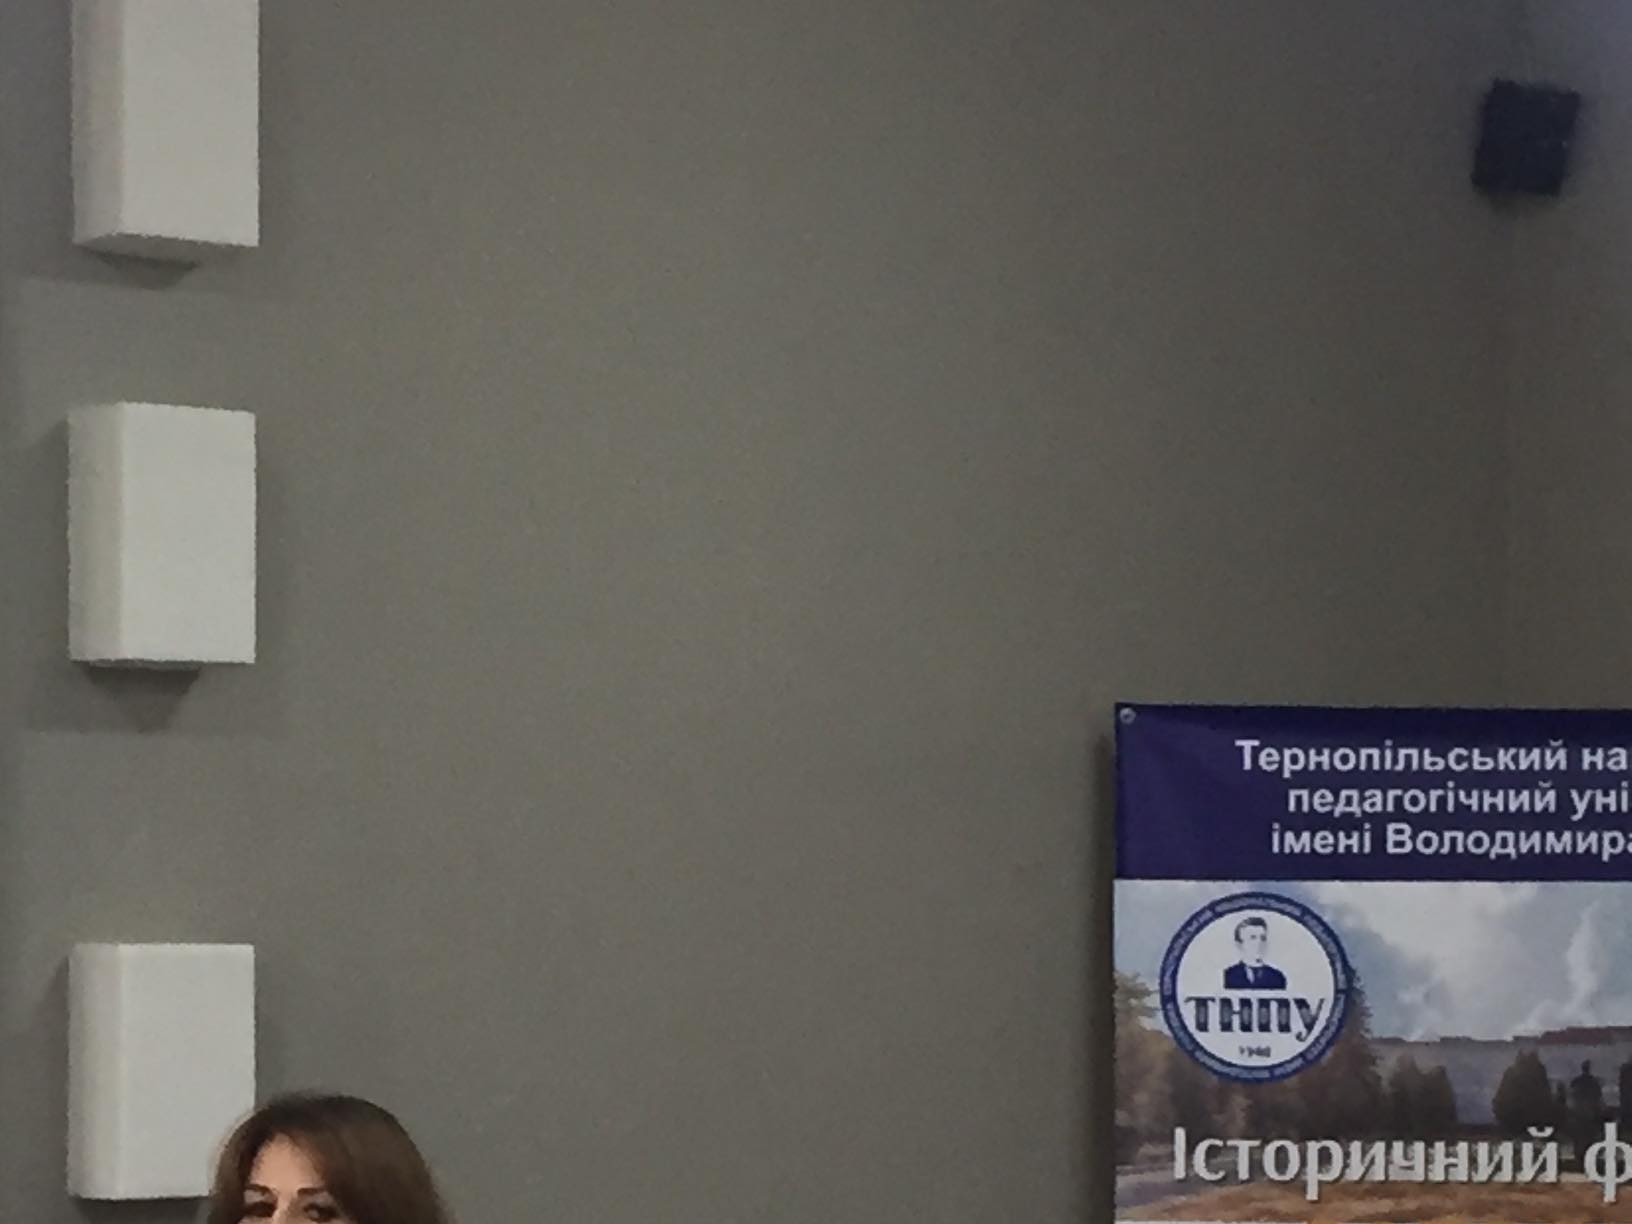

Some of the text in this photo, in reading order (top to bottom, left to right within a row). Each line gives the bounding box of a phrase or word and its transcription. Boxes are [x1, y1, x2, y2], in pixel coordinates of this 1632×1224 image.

[1234, 738, 1628, 778] Тернопільський на
[1287, 780, 1629, 822] педагогічний уні
[1271, 823, 1632, 863] імені Володимир
[1184, 996, 1325, 1042] ТНПУ
[1173, 1122, 1632, 1203] Історичний ф
